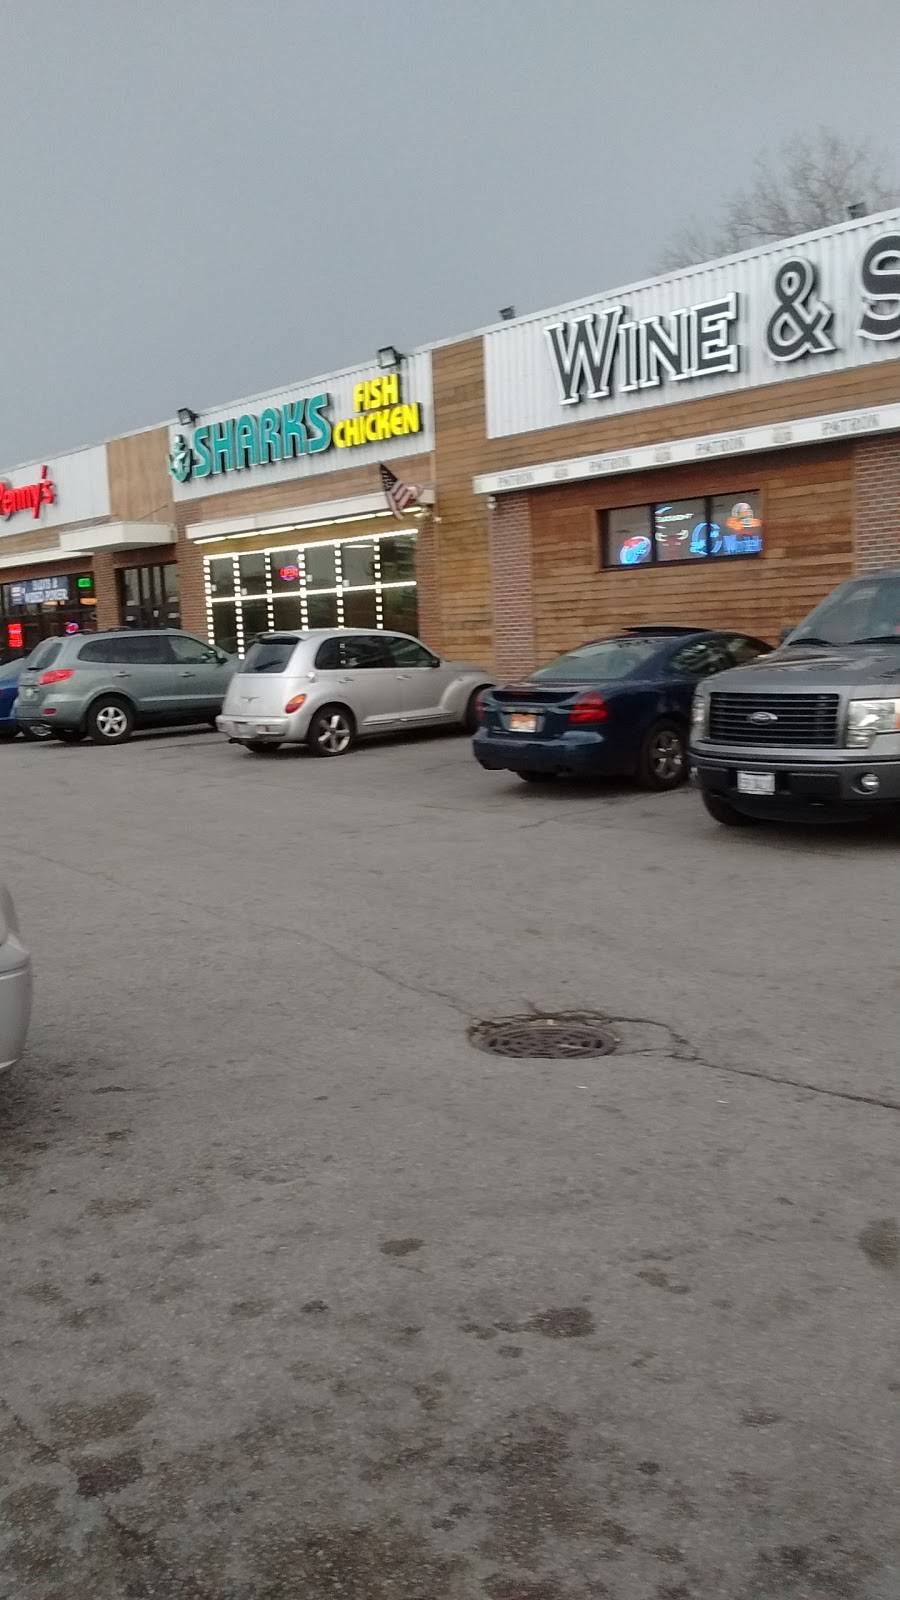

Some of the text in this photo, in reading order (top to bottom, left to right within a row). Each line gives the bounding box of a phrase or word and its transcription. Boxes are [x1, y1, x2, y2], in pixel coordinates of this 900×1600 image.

[767, 256, 837, 362] &
[332, 402, 421, 449] CHICKEN
[353, 373, 399, 413] FISH
[192, 392, 331, 479] SHARKS
